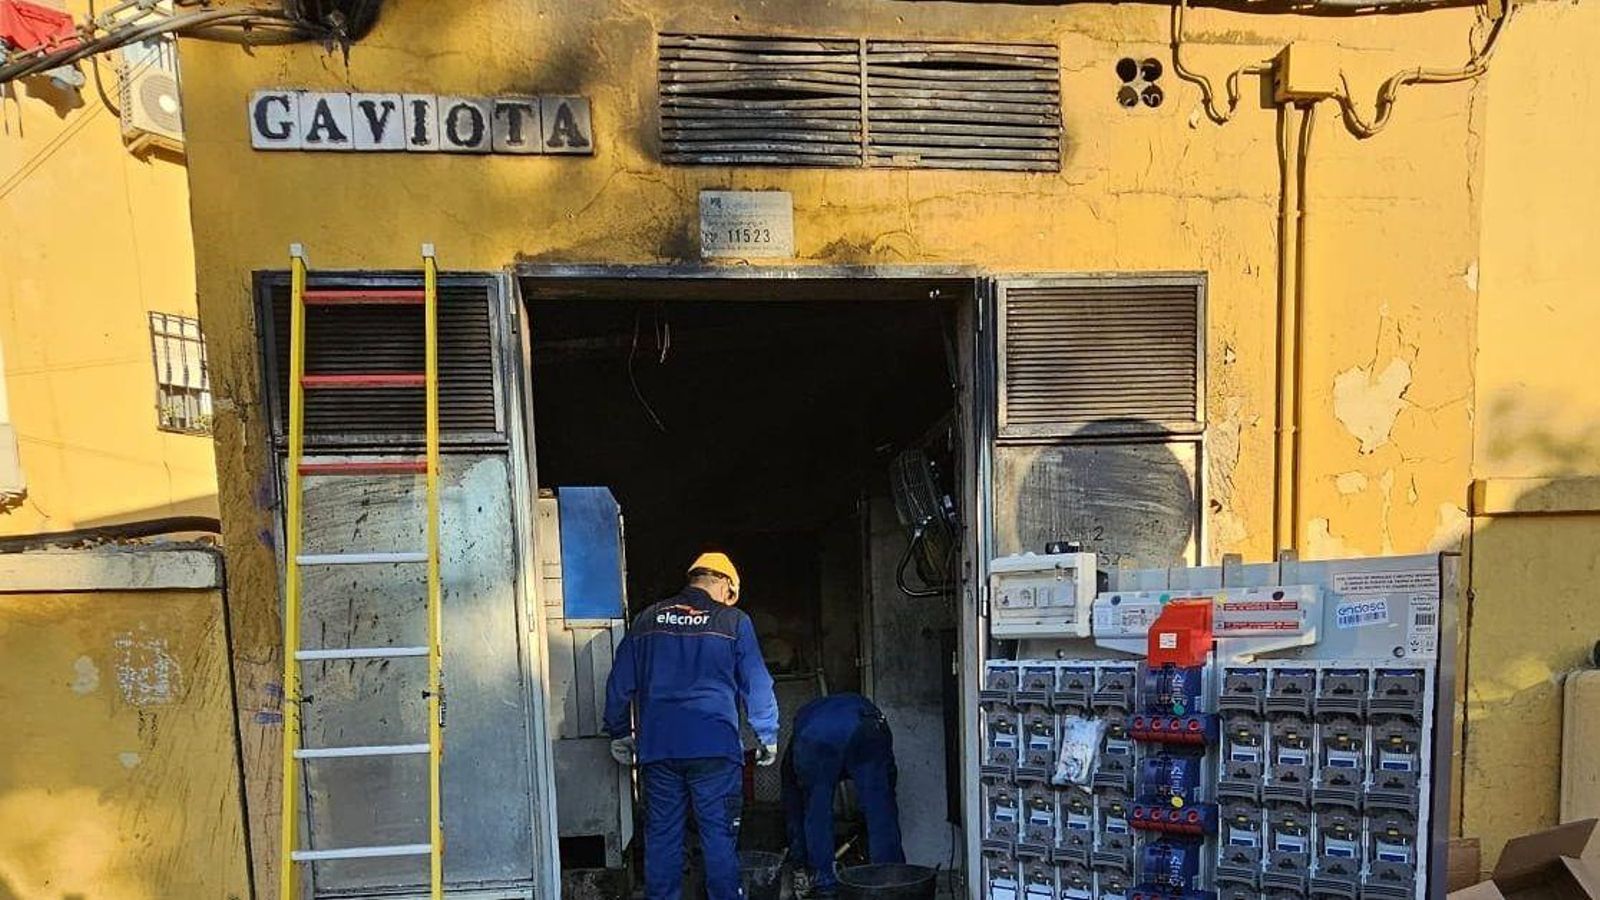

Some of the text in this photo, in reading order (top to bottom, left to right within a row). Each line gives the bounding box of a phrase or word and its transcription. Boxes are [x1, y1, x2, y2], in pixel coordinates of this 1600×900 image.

[253, 94, 590, 148] GAVIOTA
[728, 229, 770, 243] 11523
[1338, 601, 1386, 616] endesa
[656, 612, 710, 625] elecnor
